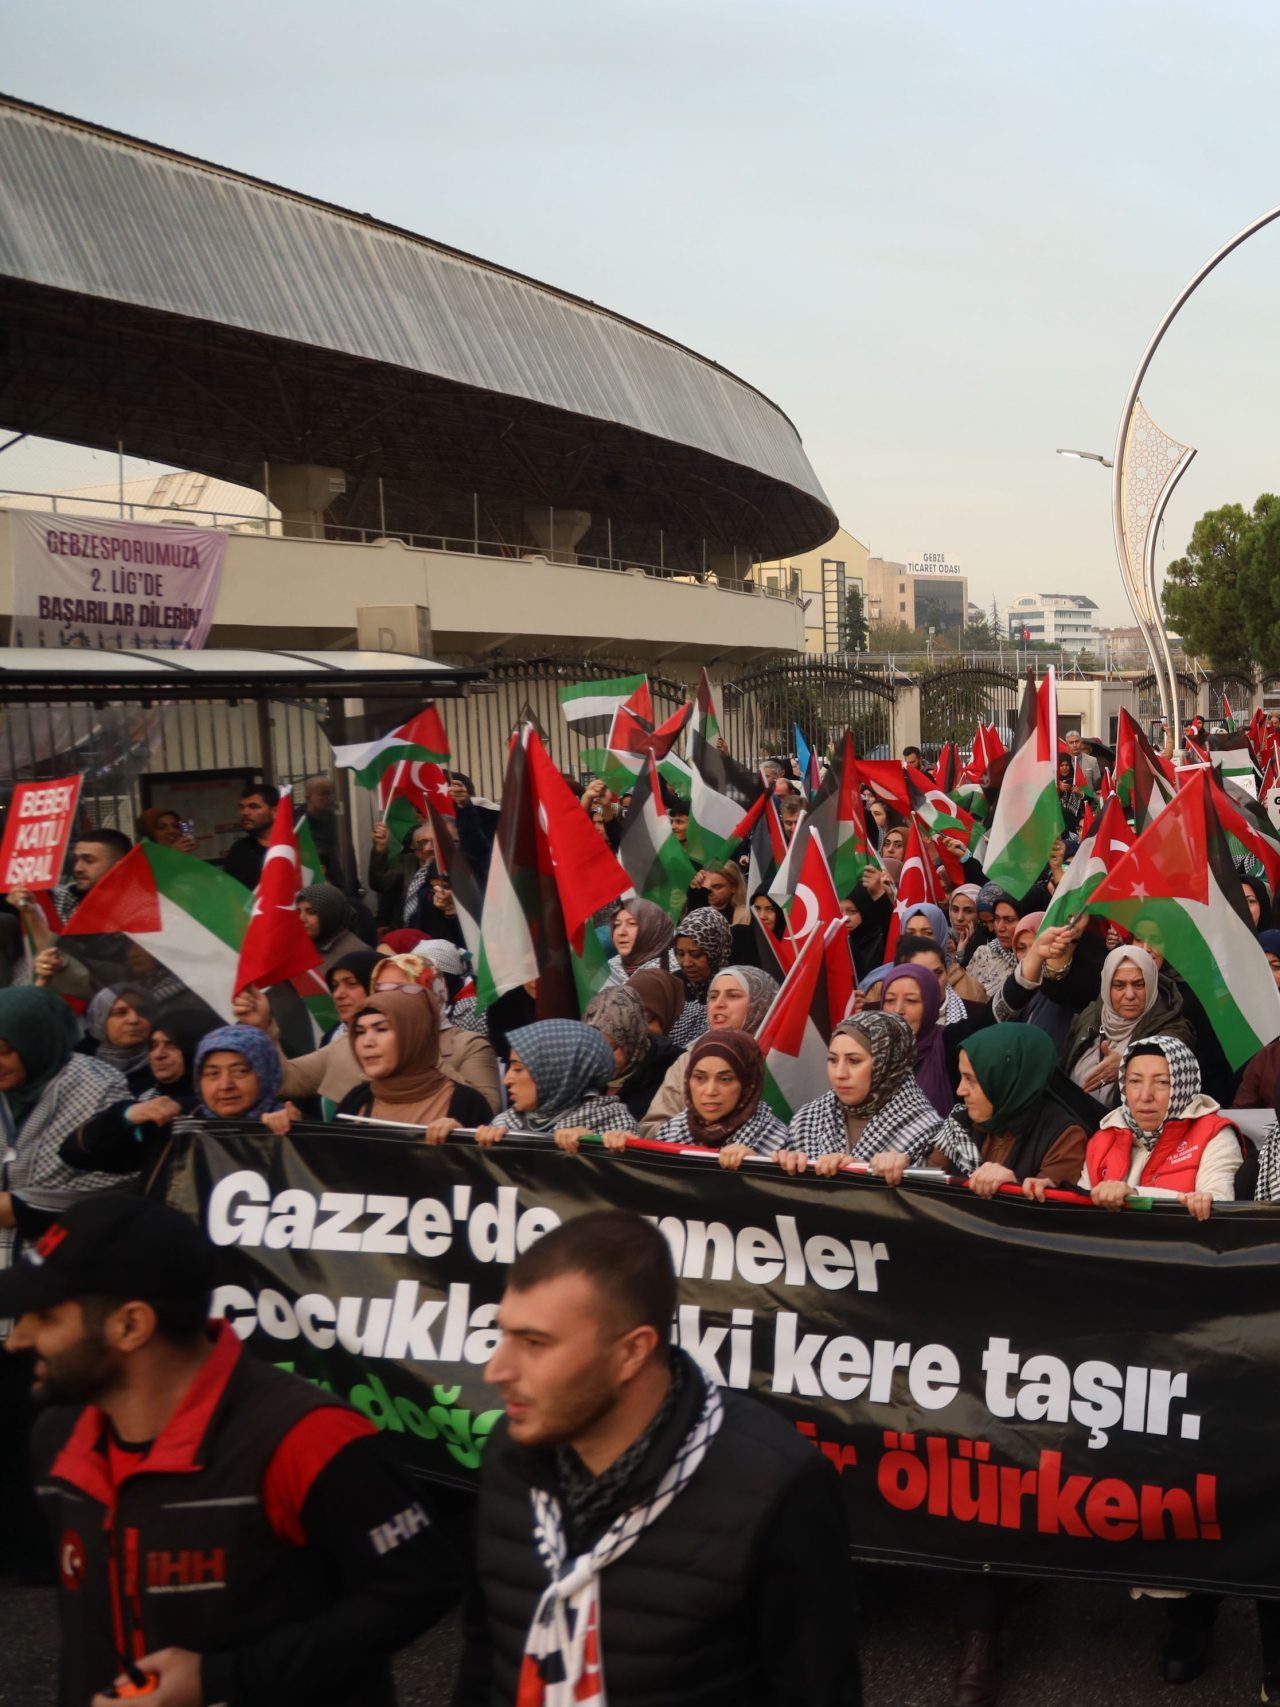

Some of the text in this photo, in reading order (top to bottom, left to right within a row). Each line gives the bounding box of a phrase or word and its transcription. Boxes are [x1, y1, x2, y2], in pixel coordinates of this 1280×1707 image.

[46, 530, 200, 569] GEBZESPORUMUZA
[923, 553, 945, 562] GEBZE
[938, 564, 961, 574] ODASI
[90, 567, 164, 597] 2. LİG'DE
[38, 595, 135, 629] BAŞARILAR
[207, 1170, 562, 1264] Gazze'de
[640, 1215, 889, 1292] nneler
[772, 1311, 961, 1410] kere
[981, 1337, 1201, 1449] taşır.
[877, 1430, 1222, 1542] ölürken!
